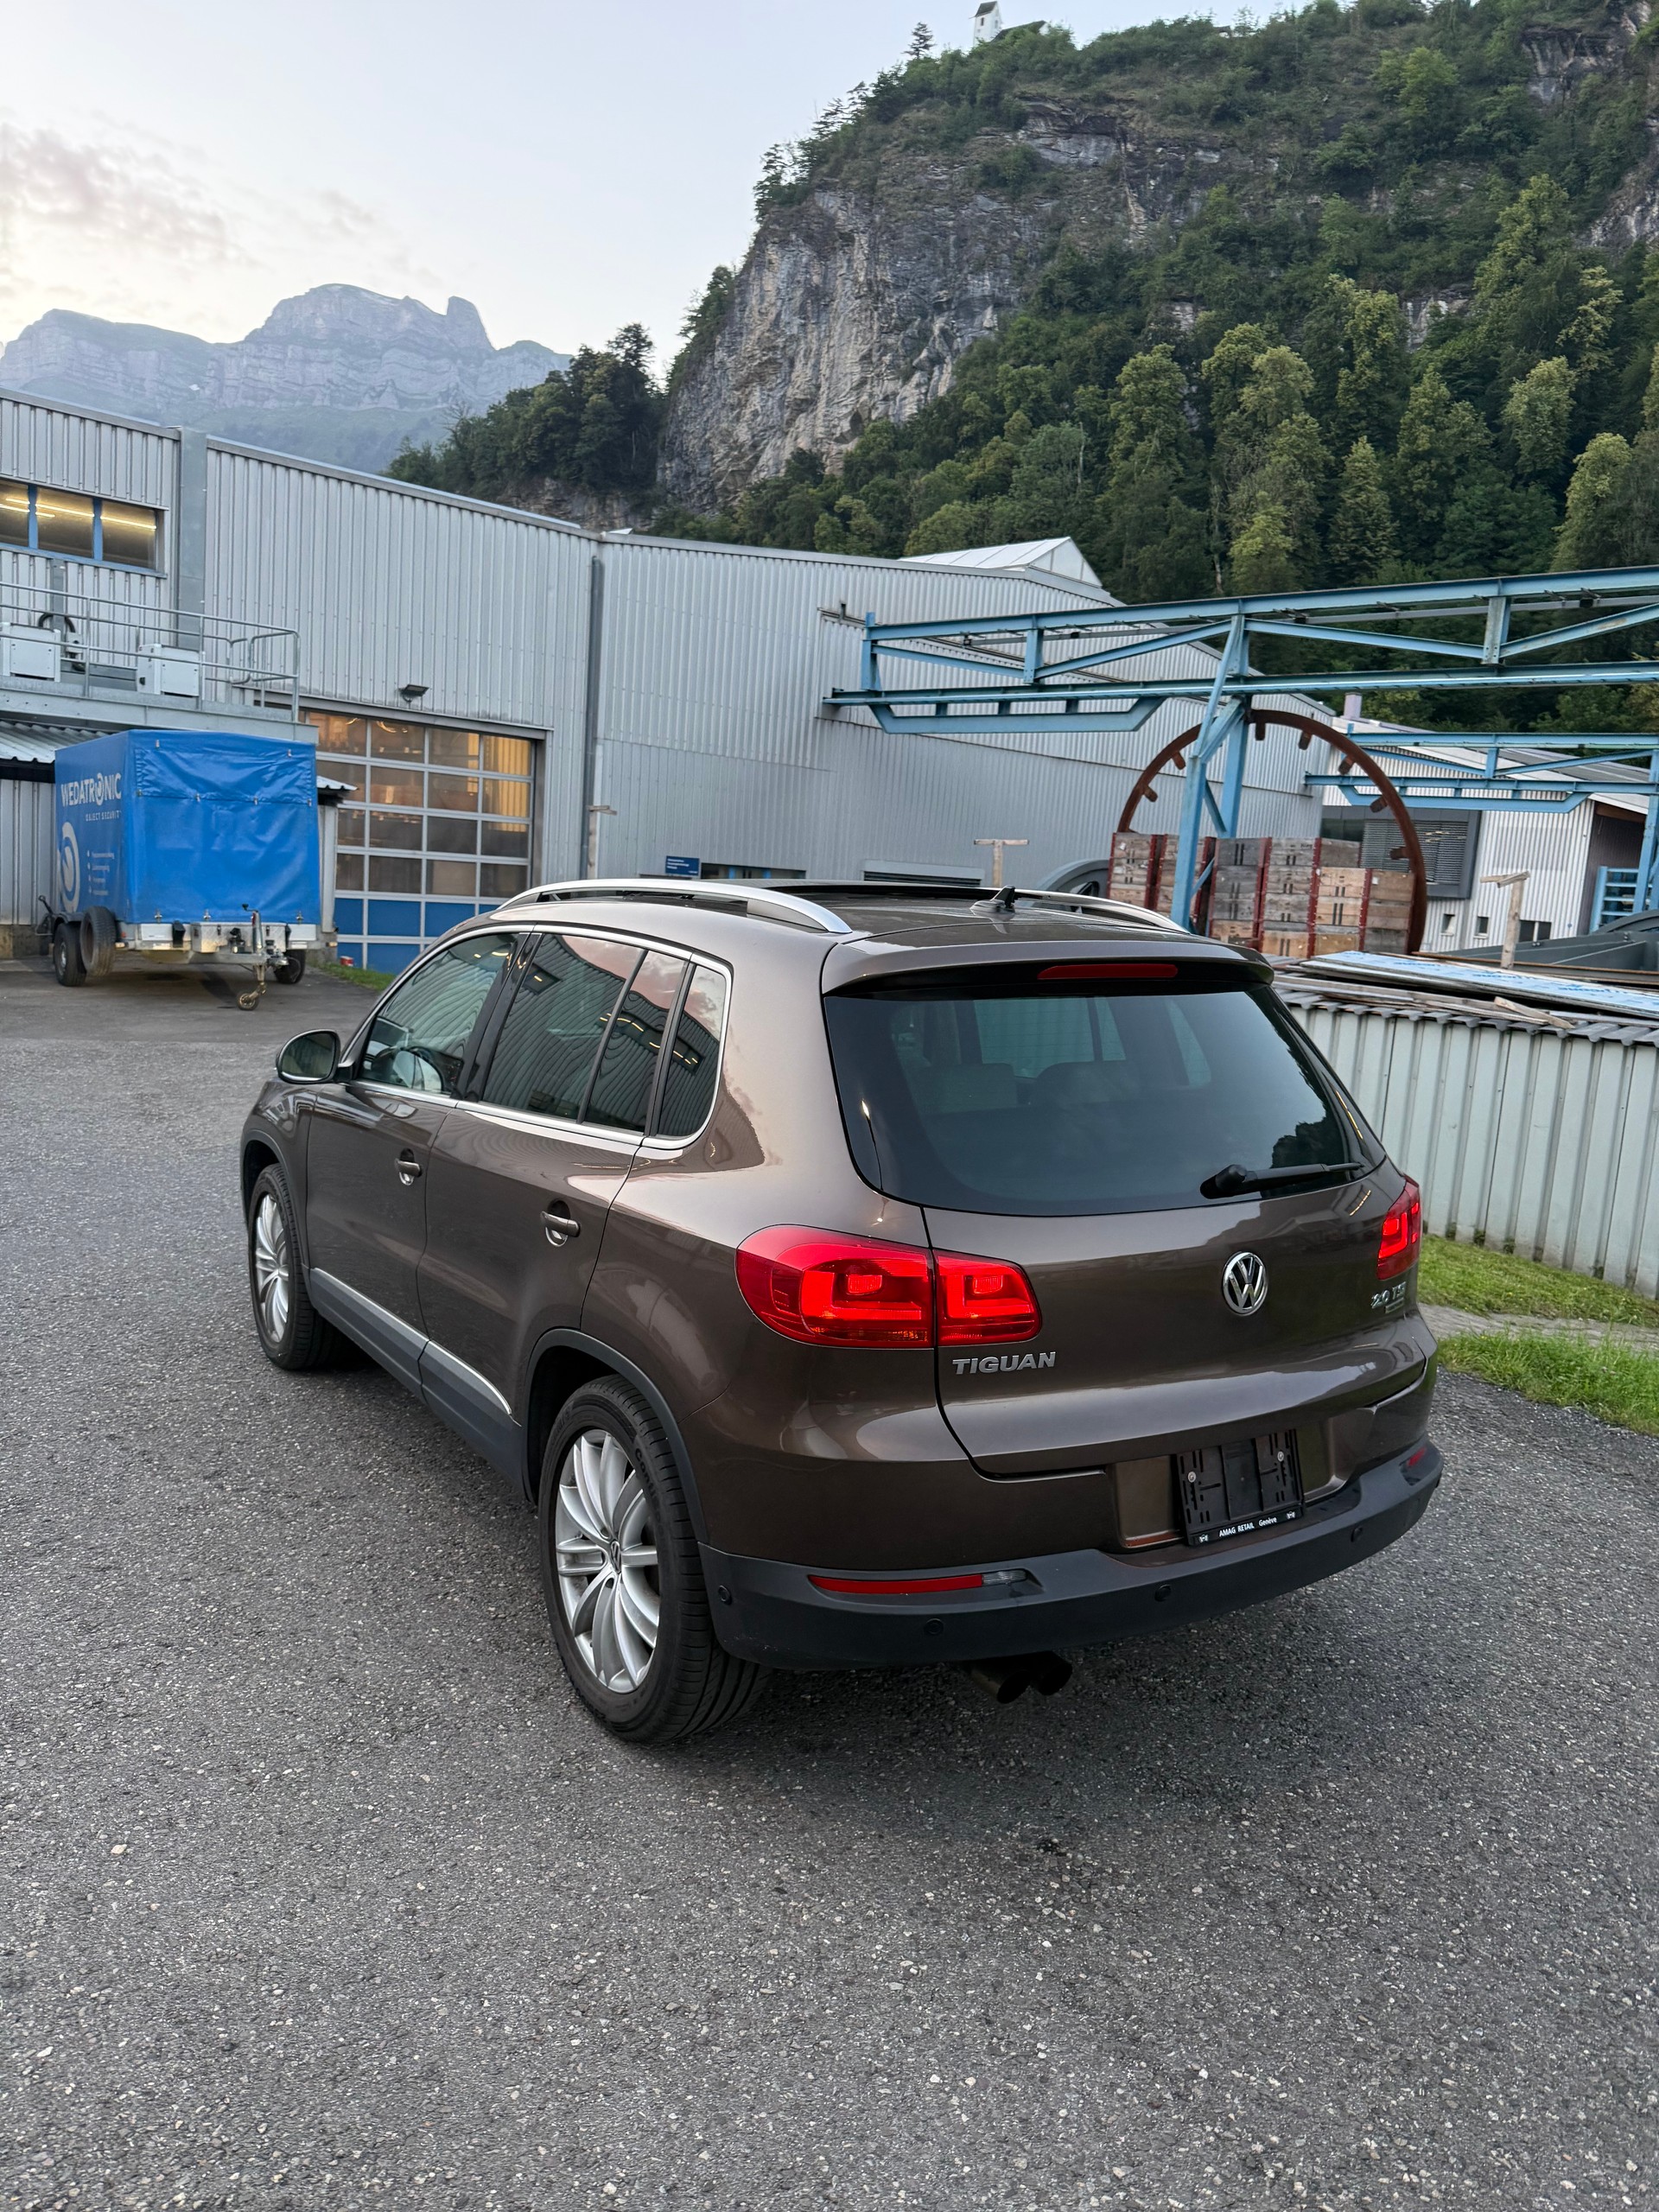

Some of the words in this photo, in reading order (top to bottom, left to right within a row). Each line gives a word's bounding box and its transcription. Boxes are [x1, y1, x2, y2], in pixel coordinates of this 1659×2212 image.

[60, 772, 121, 807] WEDATRONIC
[952, 1351, 1056, 1375] TIGUAN
[1218, 1527, 1236, 1537] AMAG
[1237, 1522, 1255, 1532] RETAIL
